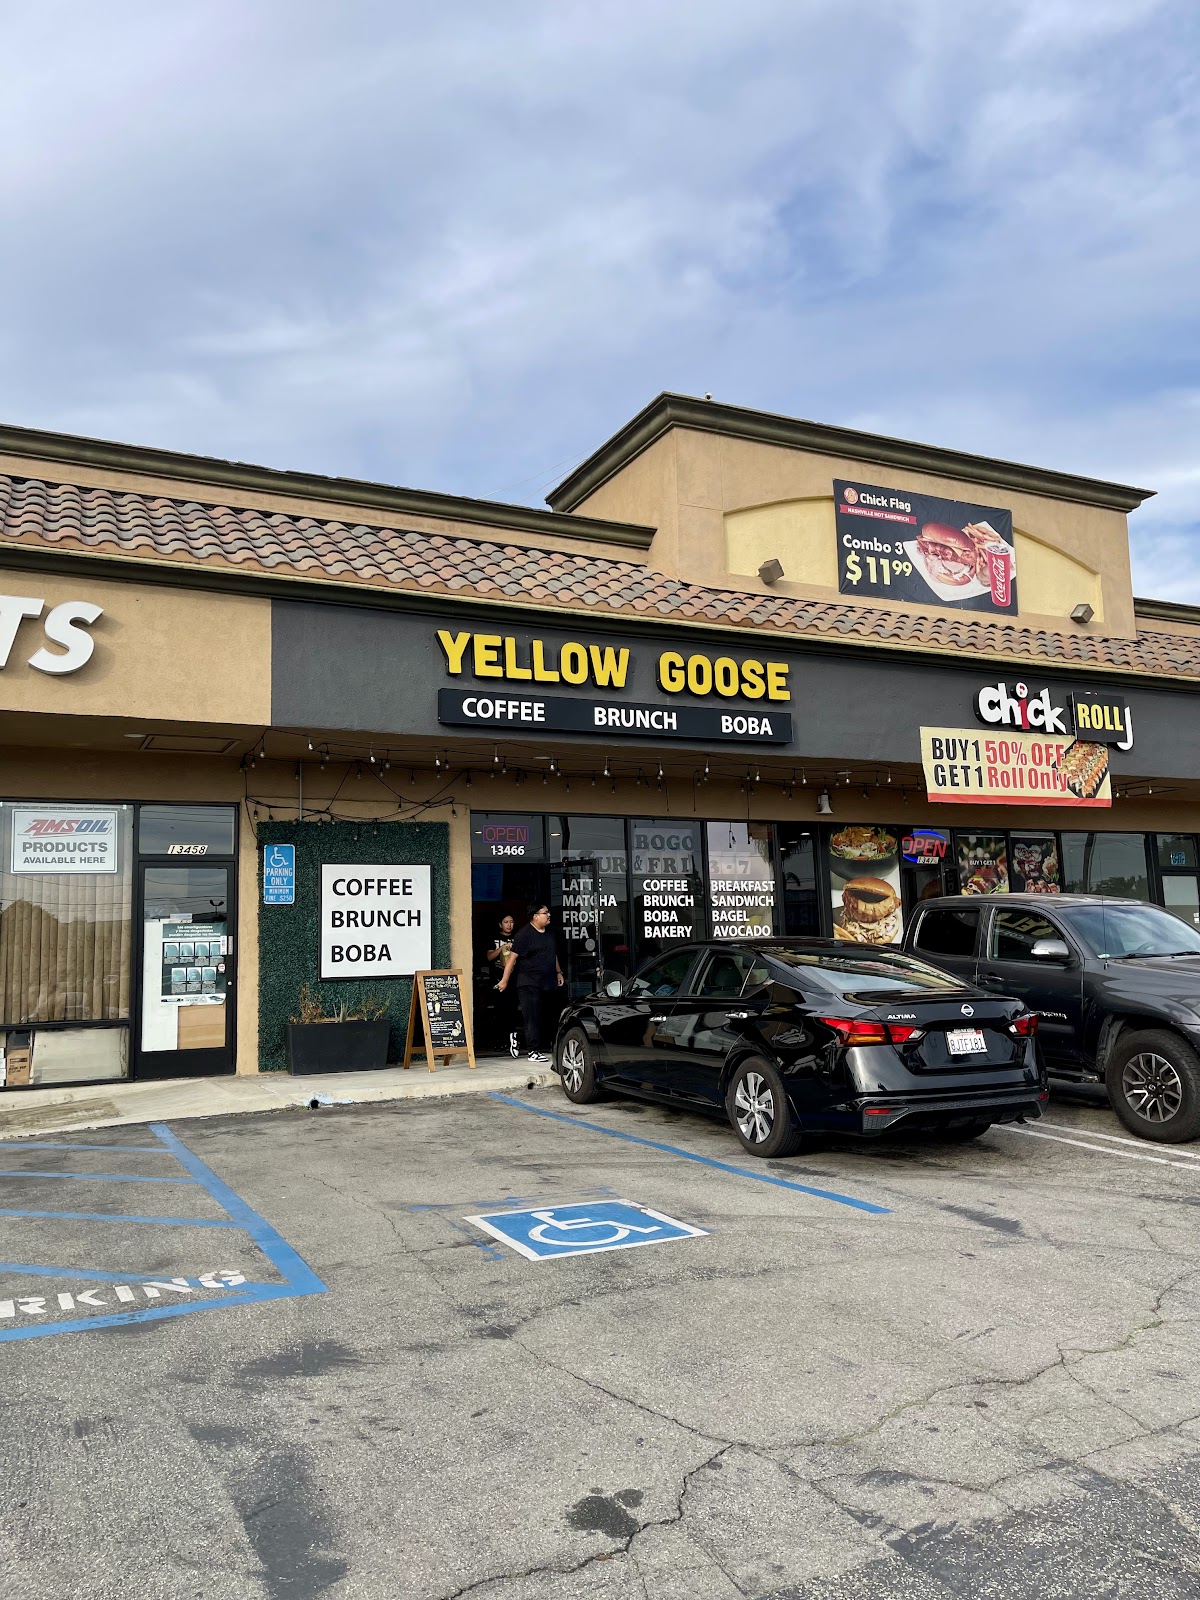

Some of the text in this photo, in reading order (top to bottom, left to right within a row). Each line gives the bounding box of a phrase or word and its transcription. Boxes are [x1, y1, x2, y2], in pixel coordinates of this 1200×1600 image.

[860, 493, 911, 513] Chick Flag
[847, 507, 873, 517] NASHVILLE
[843, 534, 904, 555] Combo 3
[0, 595, 104, 676] TS
[436, 629, 792, 701] YELLOW GOOSE
[462, 697, 773, 736] COFFEE BRUNCH BOBA
[1077, 703, 1124, 731] ROLL
[985, 740, 1028, 766] 50%
[1031, 743, 1065, 767] OFF
[987, 766, 1024, 789] Roll
[1028, 768, 1067, 792] Only
[22, 819, 112, 836] AMSOIL
[485, 827, 527, 842] OPEN
[22, 842, 108, 853] PRODUCTS
[635, 834, 694, 850] BOGO
[902, 836, 947, 857] OPEN
[170, 845, 206, 854] 13458
[490, 845, 525, 856] 13466
[561, 856, 627, 873] UR
[634, 855, 643, 871] &
[266, 867, 293, 877] PARKING
[271, 877, 288, 886] ONLY
[332, 878, 413, 896] COFFEE
[643, 879, 688, 892] COFFEE
[711, 880, 775, 892] BREAKFAST
[643, 895, 694, 907] BRUNCH
[711, 895, 774, 907] SANDWICH
[331, 910, 421, 928] BRUNCH
[562, 911, 605, 923] FROST
[644, 910, 678, 923] BOBA
[712, 910, 750, 922] BAGEL
[563, 927, 590, 940] TEA
[644, 926, 693, 939] BAKERY
[713, 925, 771, 937] AVOCADO
[331, 944, 392, 963] BOBA
